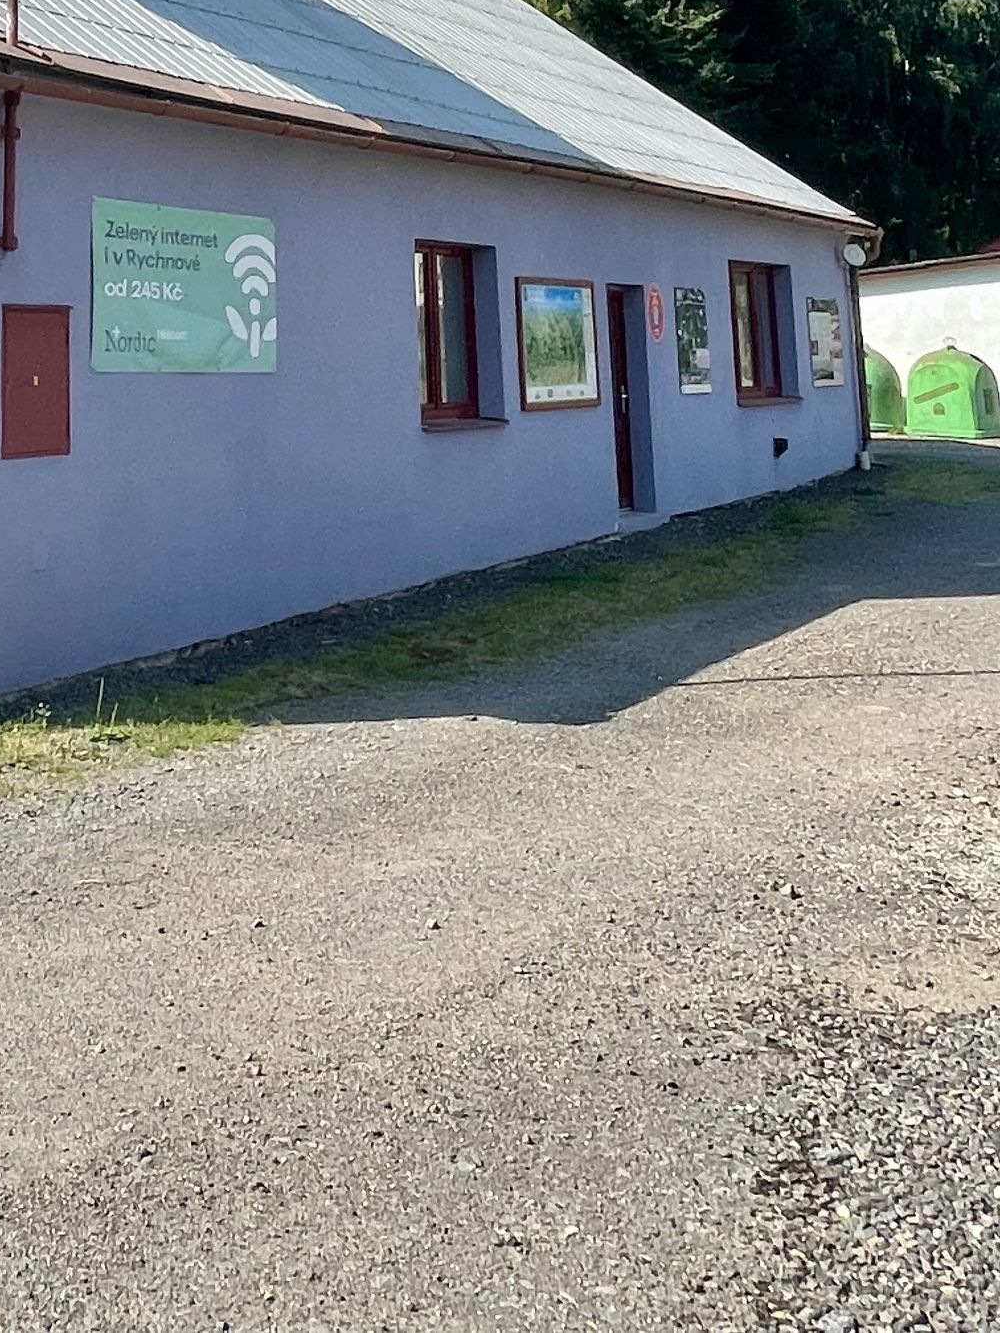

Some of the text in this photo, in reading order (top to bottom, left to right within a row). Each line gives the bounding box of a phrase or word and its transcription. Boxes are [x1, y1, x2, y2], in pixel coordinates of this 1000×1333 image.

[105, 220, 218, 248] Zelený internet
[113, 251, 123, 265] v
[104, 279, 184, 301] od 245 Kč
[104, 329, 157, 353] Nordic
